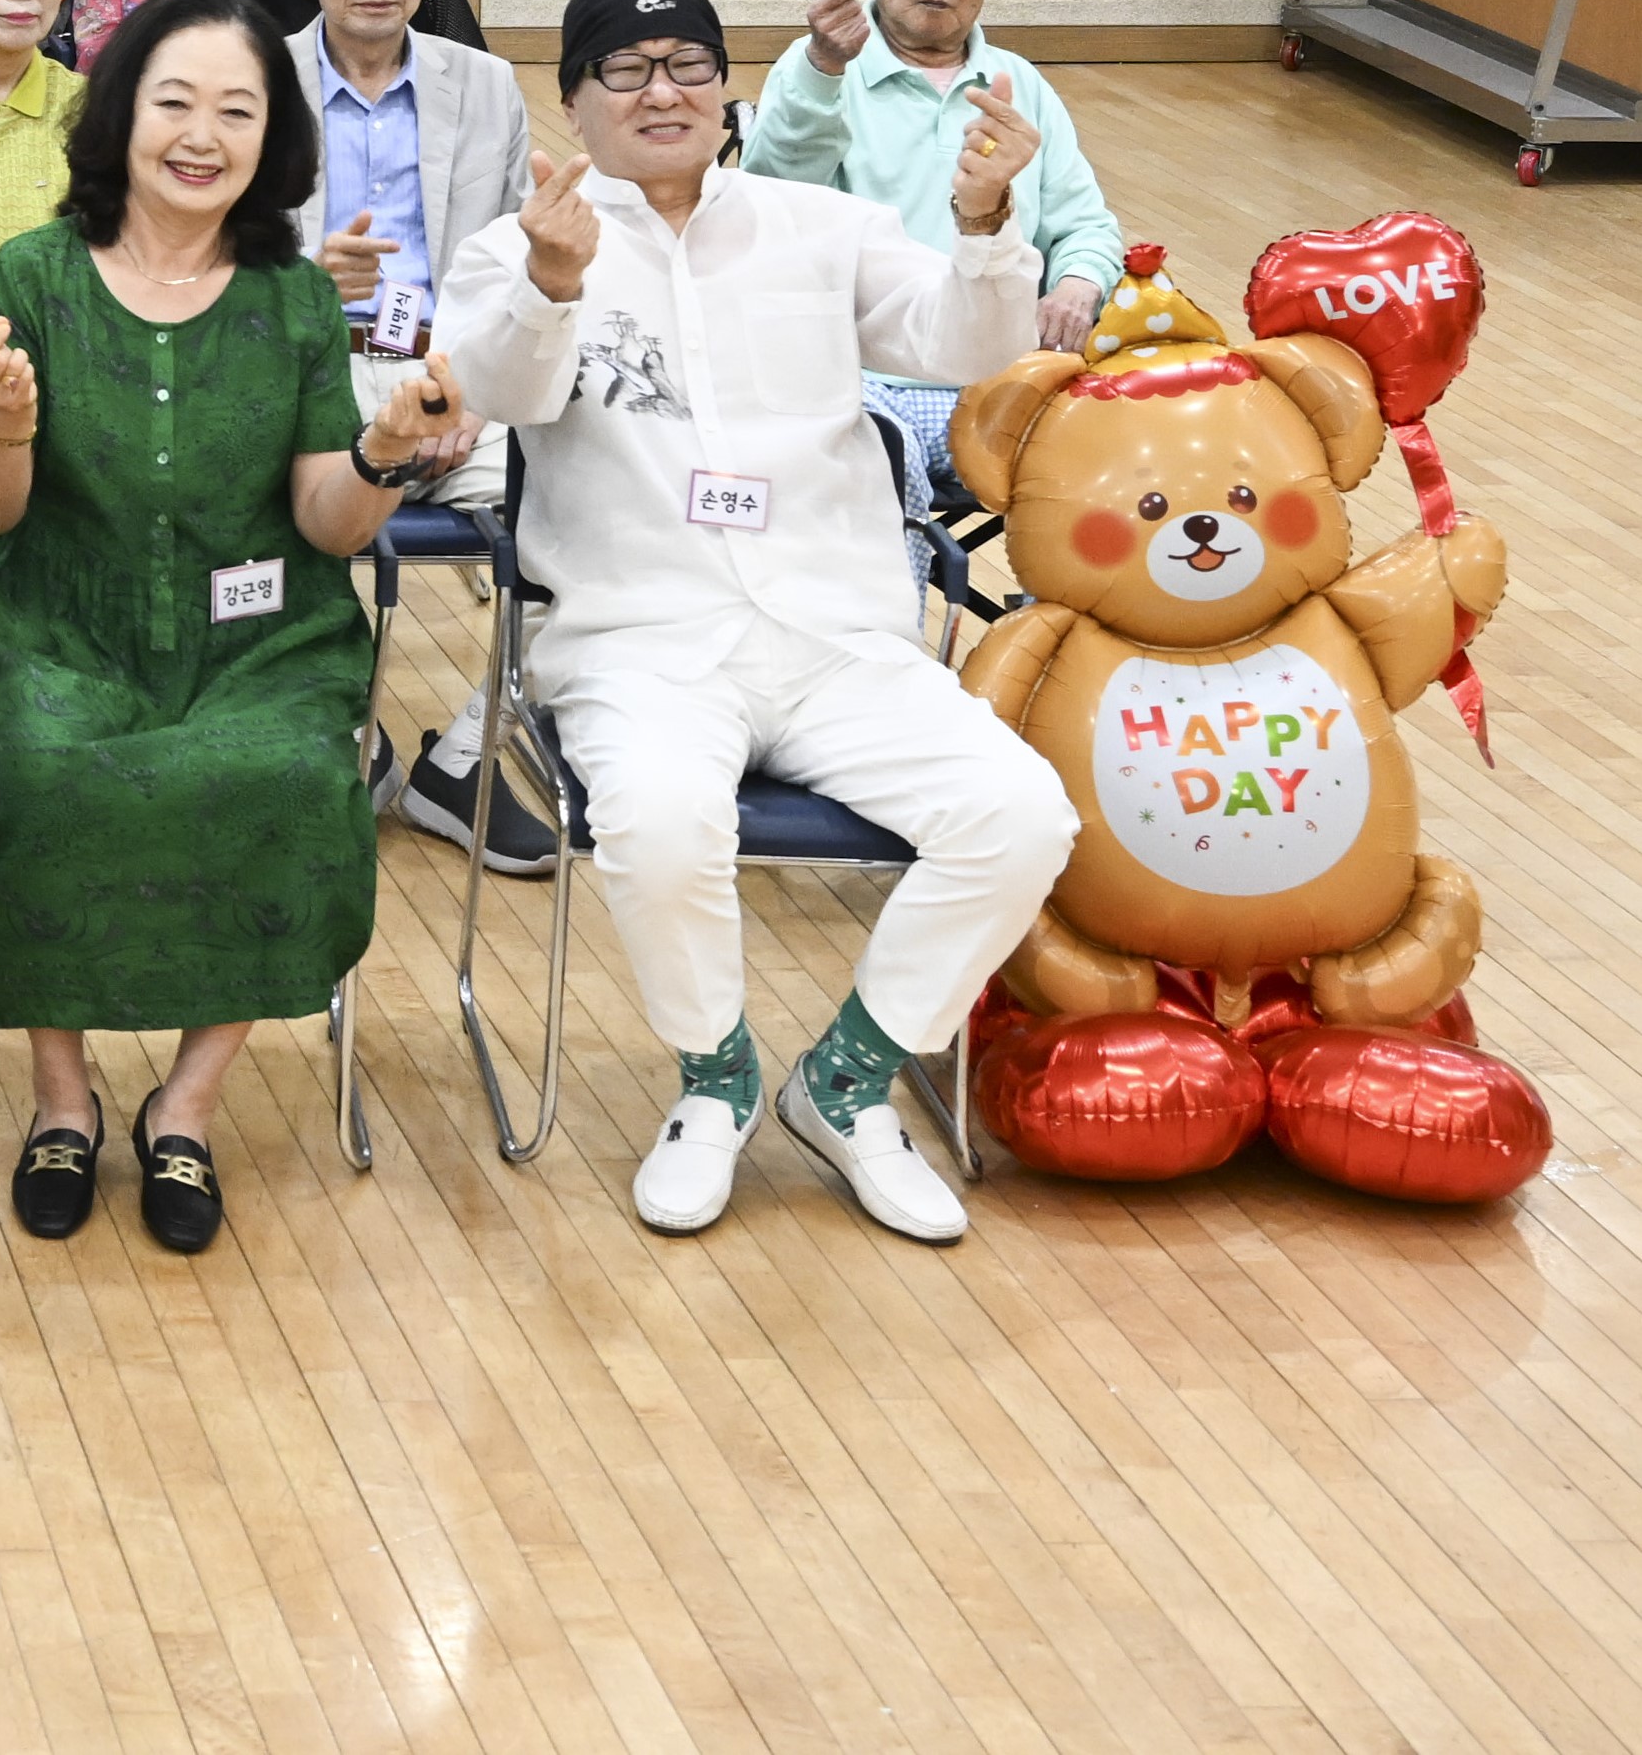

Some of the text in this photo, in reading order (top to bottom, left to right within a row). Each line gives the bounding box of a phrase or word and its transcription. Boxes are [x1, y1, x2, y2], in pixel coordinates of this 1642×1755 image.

[1314, 260, 1456, 321] LOVE
[699, 488, 759, 514] 손영수
[222, 577, 273, 607] 강근영
[1120, 701, 1342, 758] HAPPY
[1171, 767, 1310, 817] DAY
